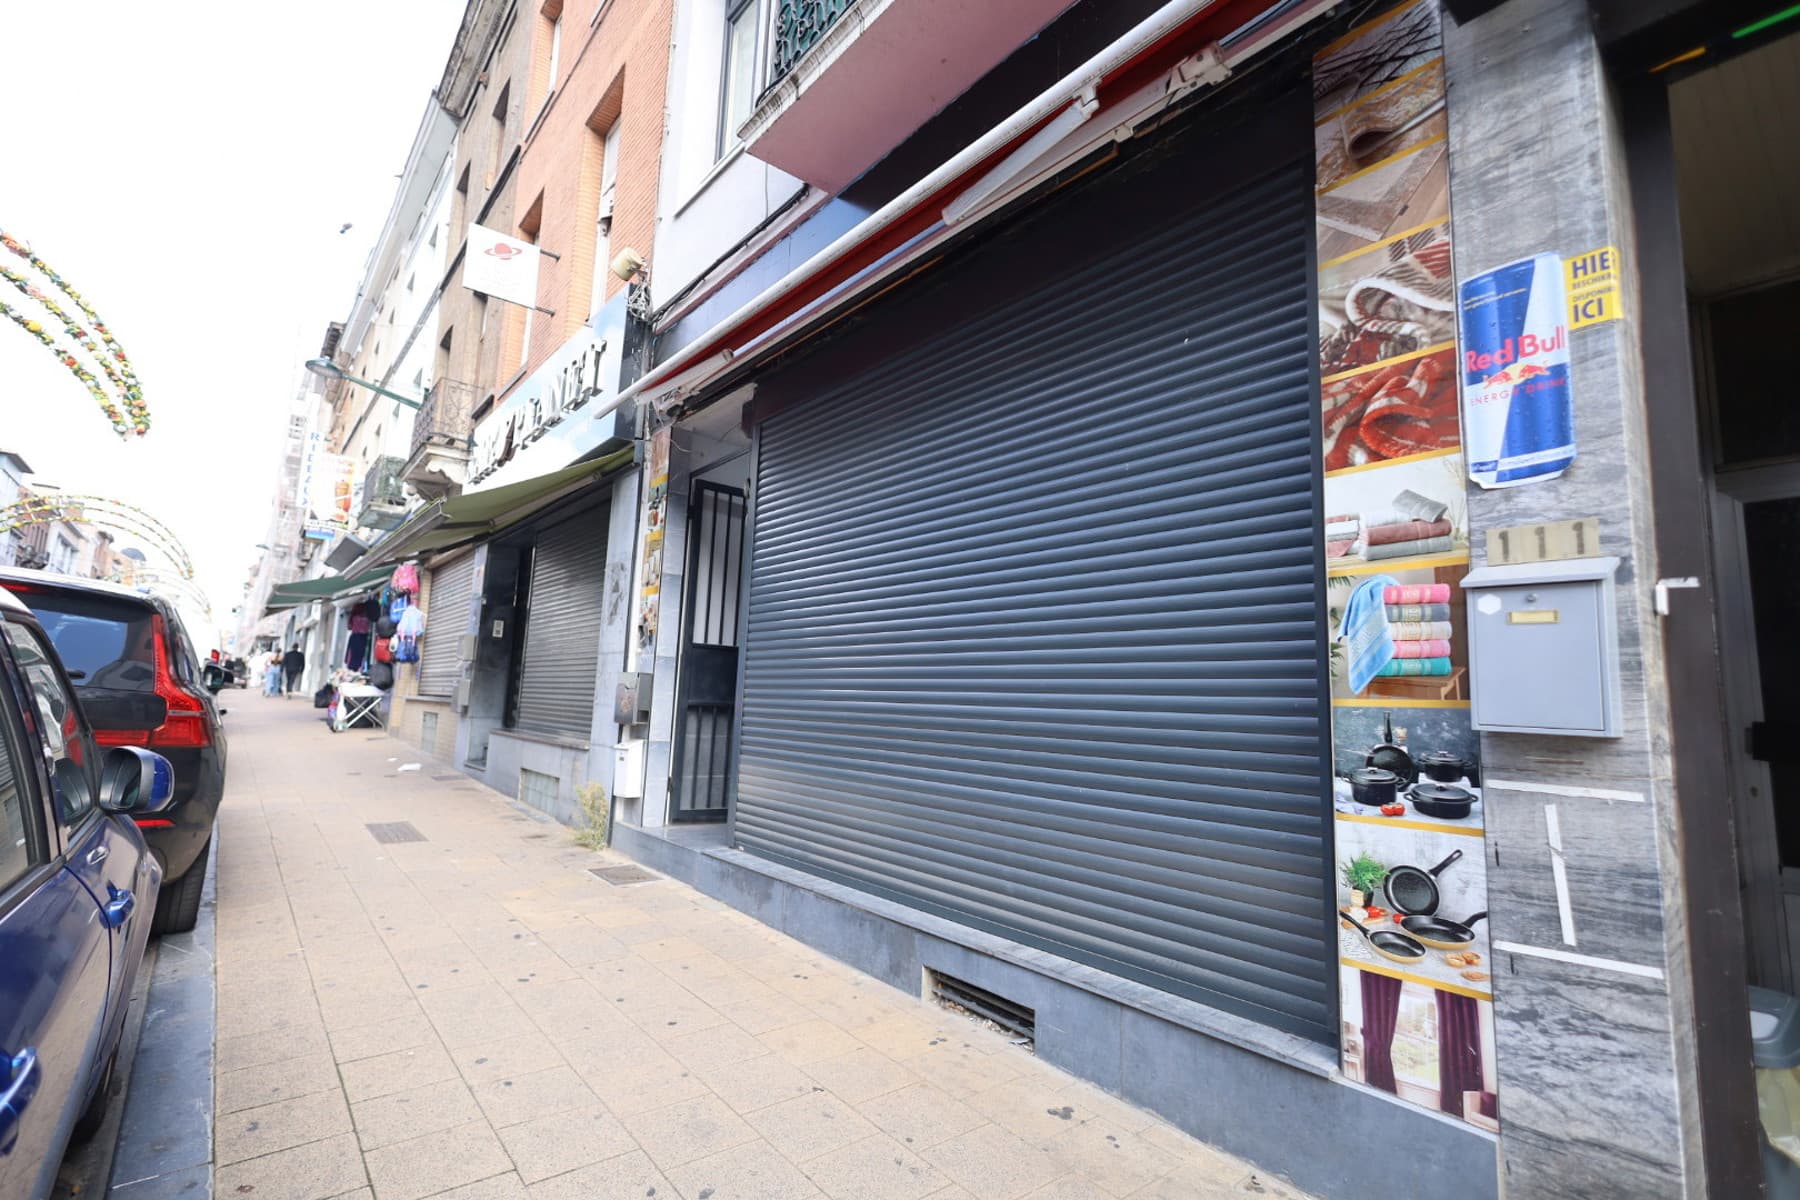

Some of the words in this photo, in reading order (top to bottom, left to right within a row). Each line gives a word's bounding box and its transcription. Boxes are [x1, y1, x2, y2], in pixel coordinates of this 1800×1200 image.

[1573, 297, 1603, 323] ICI
[1465, 338, 1514, 373] Red
[1517, 325, 1566, 358] Bull
[1470, 386, 1520, 406] ENERGY
